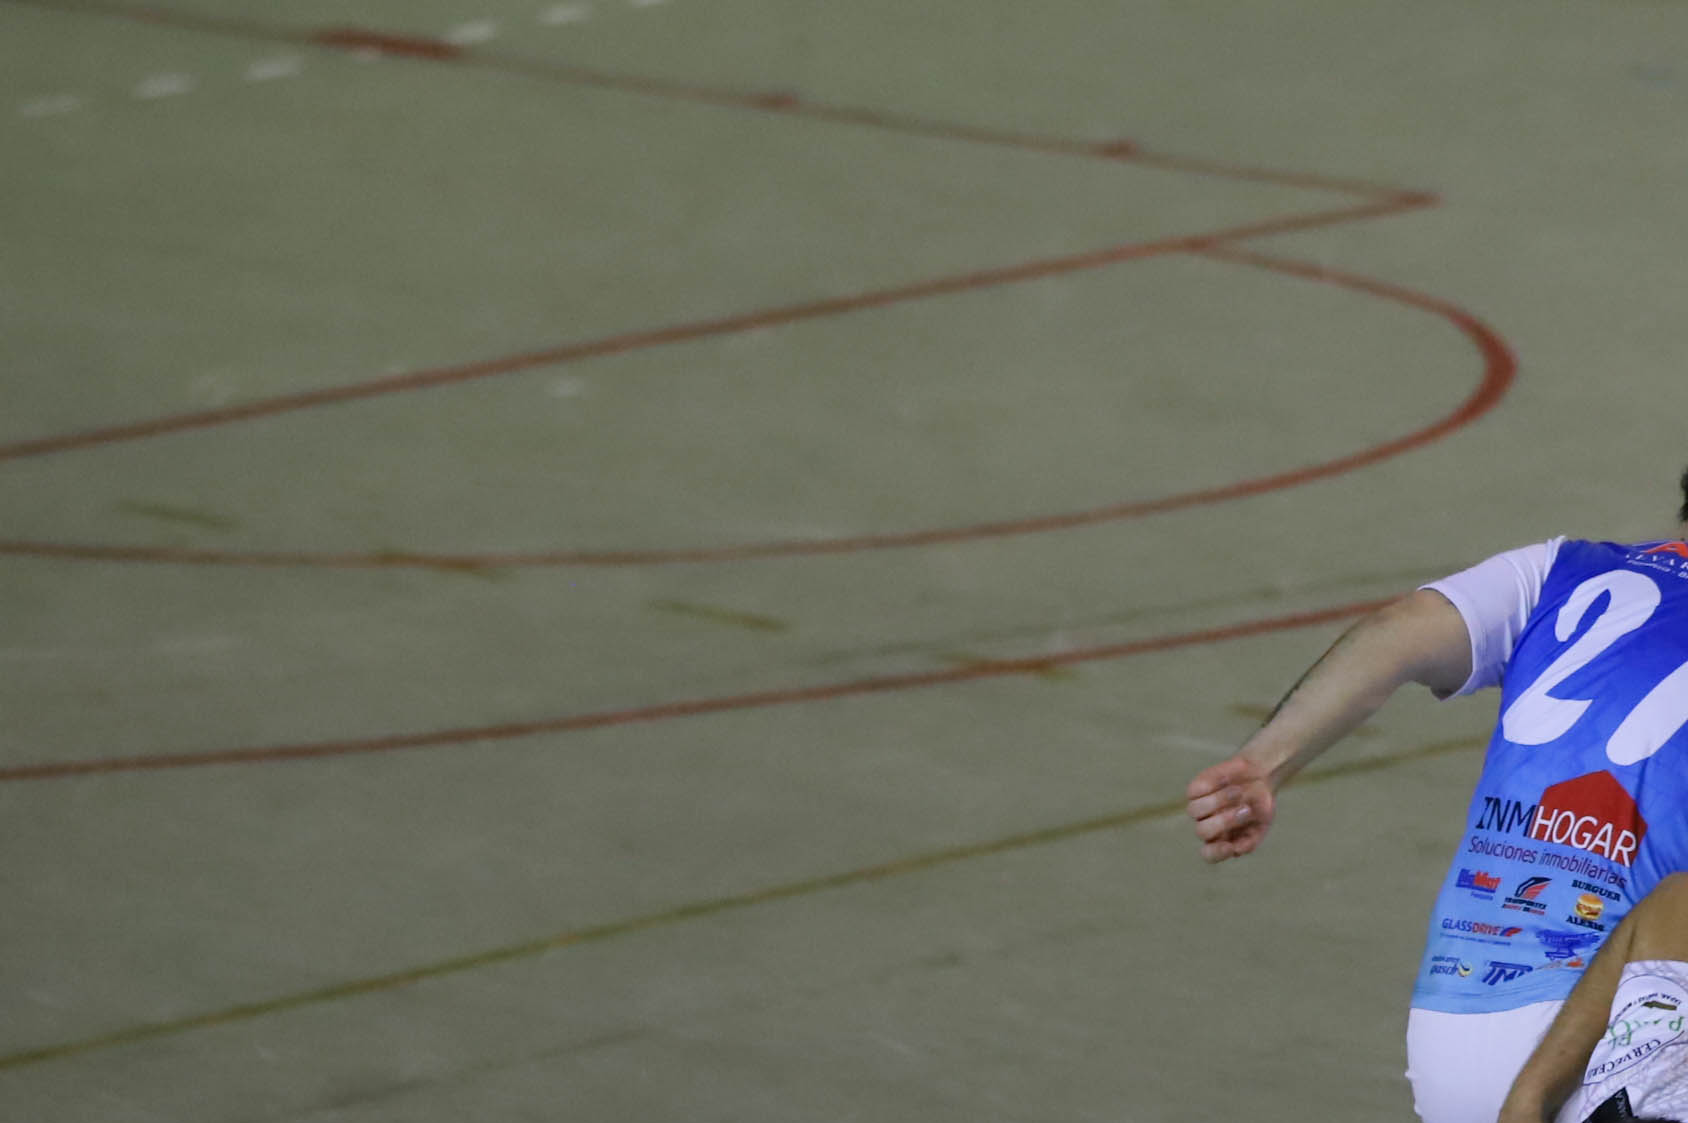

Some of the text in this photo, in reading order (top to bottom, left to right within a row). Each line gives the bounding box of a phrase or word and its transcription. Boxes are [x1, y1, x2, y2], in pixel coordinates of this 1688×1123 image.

[1469, 835, 1628, 889] Soluciones inmobiliarias
[1571, 880, 1621, 902] BURGUER
[1565, 915, 1605, 931] ALEXIS
